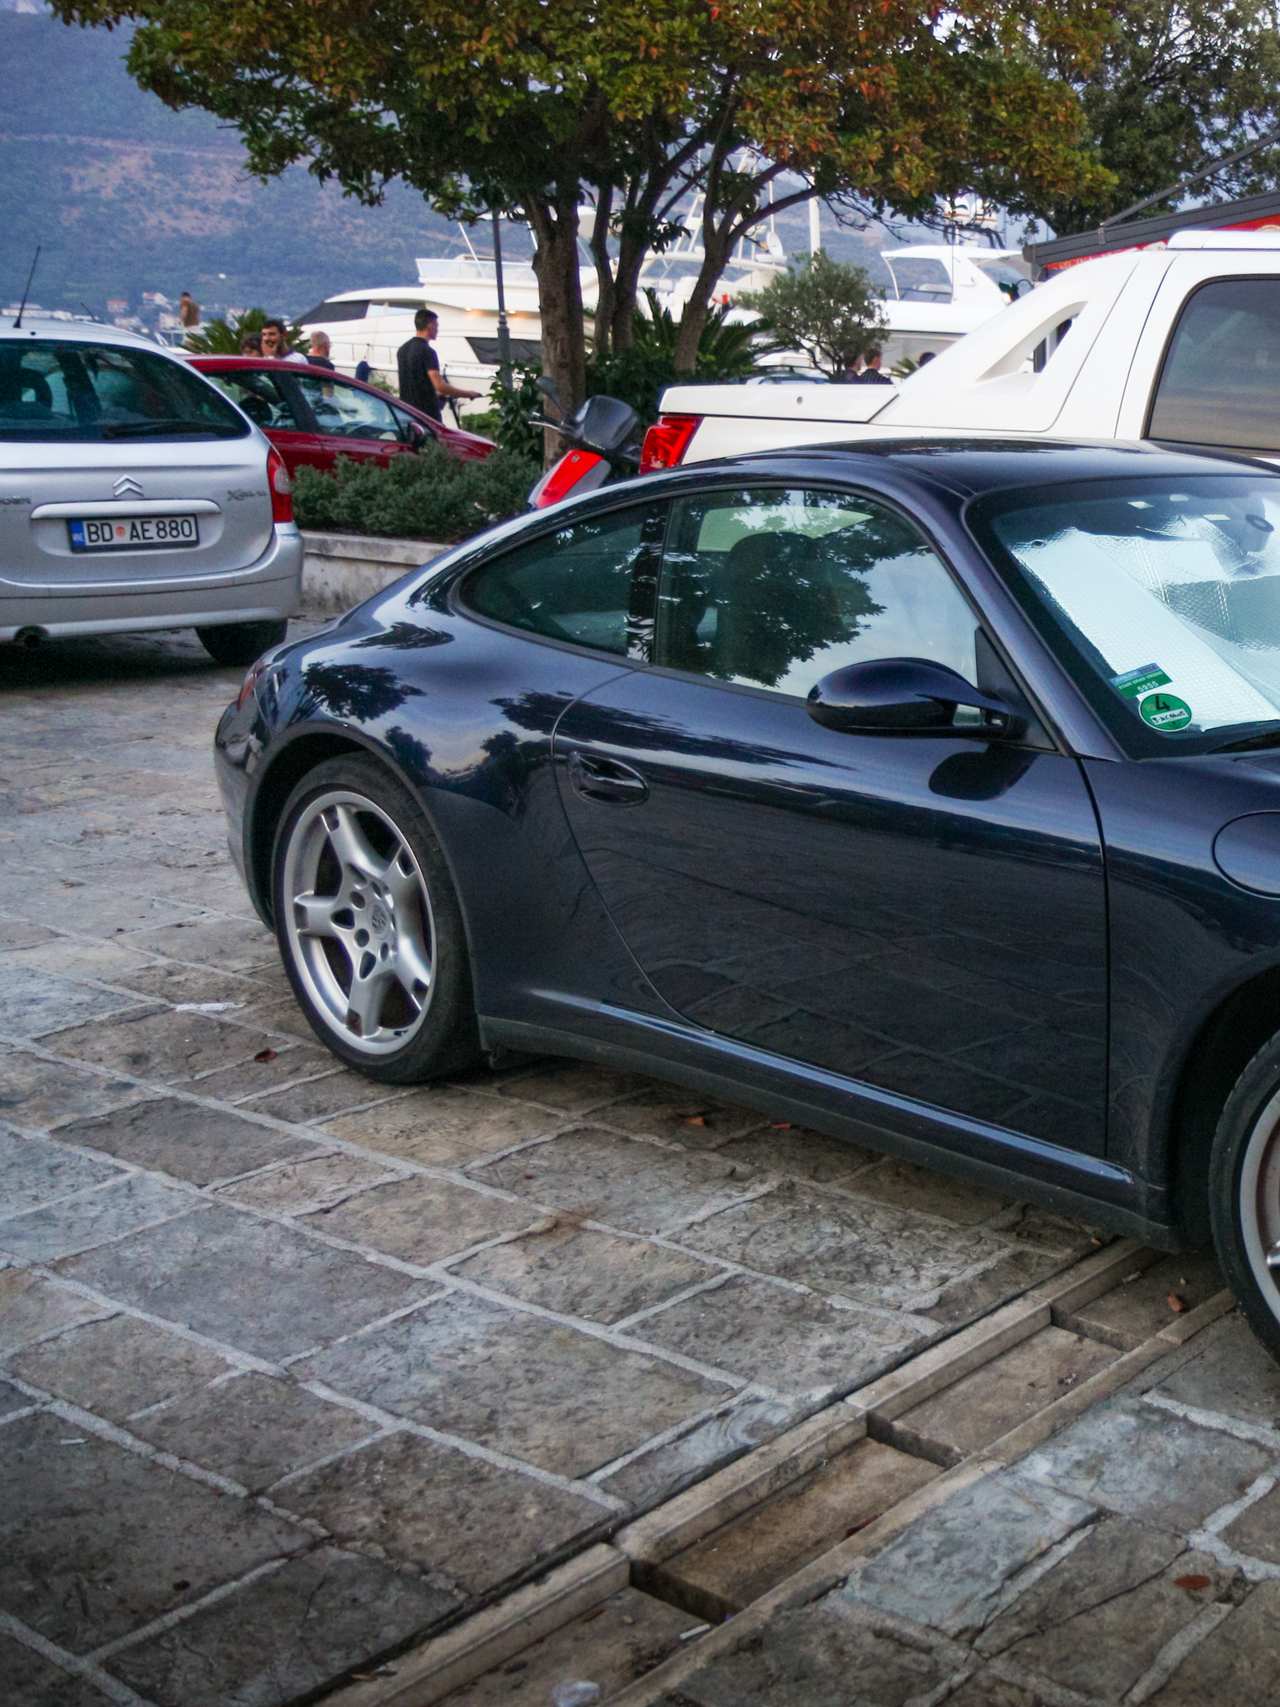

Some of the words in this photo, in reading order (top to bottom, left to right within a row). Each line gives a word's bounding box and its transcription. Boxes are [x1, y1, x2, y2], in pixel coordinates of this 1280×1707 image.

[86, 522, 114, 543] BD
[129, 518, 194, 541] AE880
[1155, 695, 1171, 711] 4
